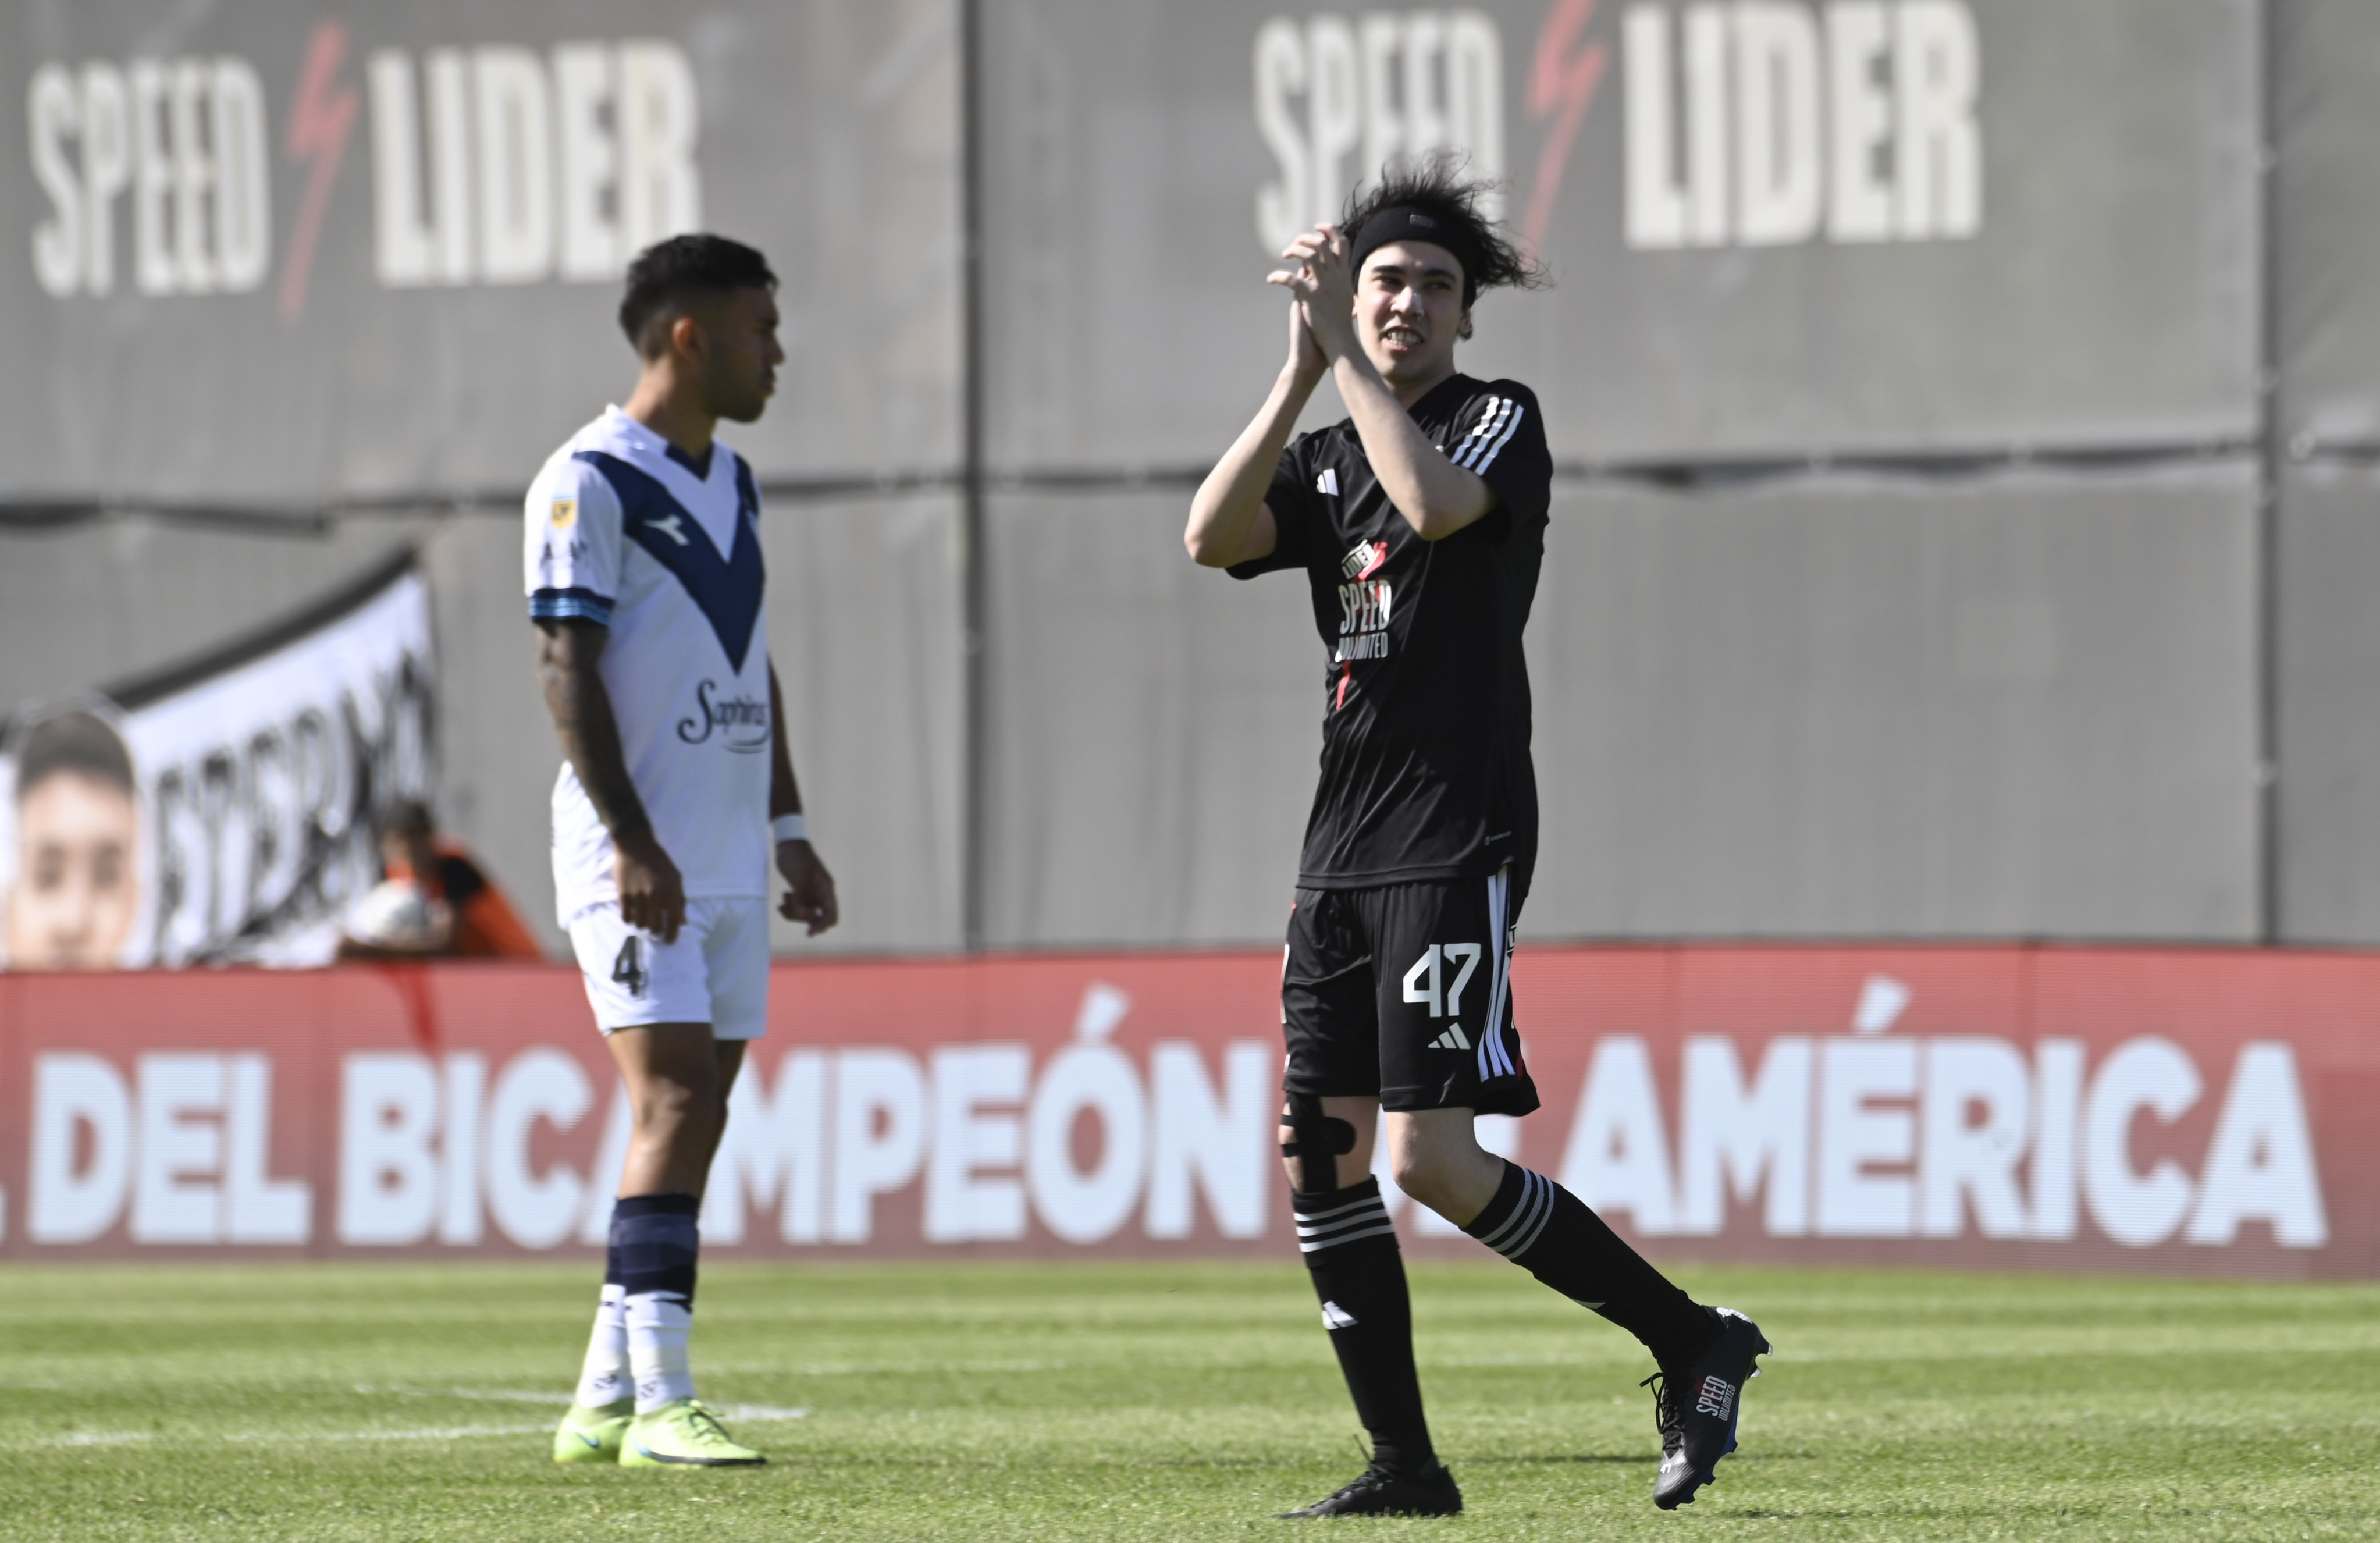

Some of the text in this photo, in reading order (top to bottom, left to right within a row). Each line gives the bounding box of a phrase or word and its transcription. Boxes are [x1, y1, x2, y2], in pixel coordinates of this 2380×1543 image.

[1623, 0, 1981, 249] LIDER
[30, 41, 702, 296] SPEED LIDER
[1339, 580, 1391, 634] SPEED
[612, 934, 648, 1000] 4
[1403, 943, 1481, 1017] 47
[27, 1050, 312, 1244] DEL
[1550, 975, 2328, 1247] AMÉRICA
[1696, 1375, 1727, 1417] SPEED
[1718, 1384, 1736, 1421] UNLIMITED
